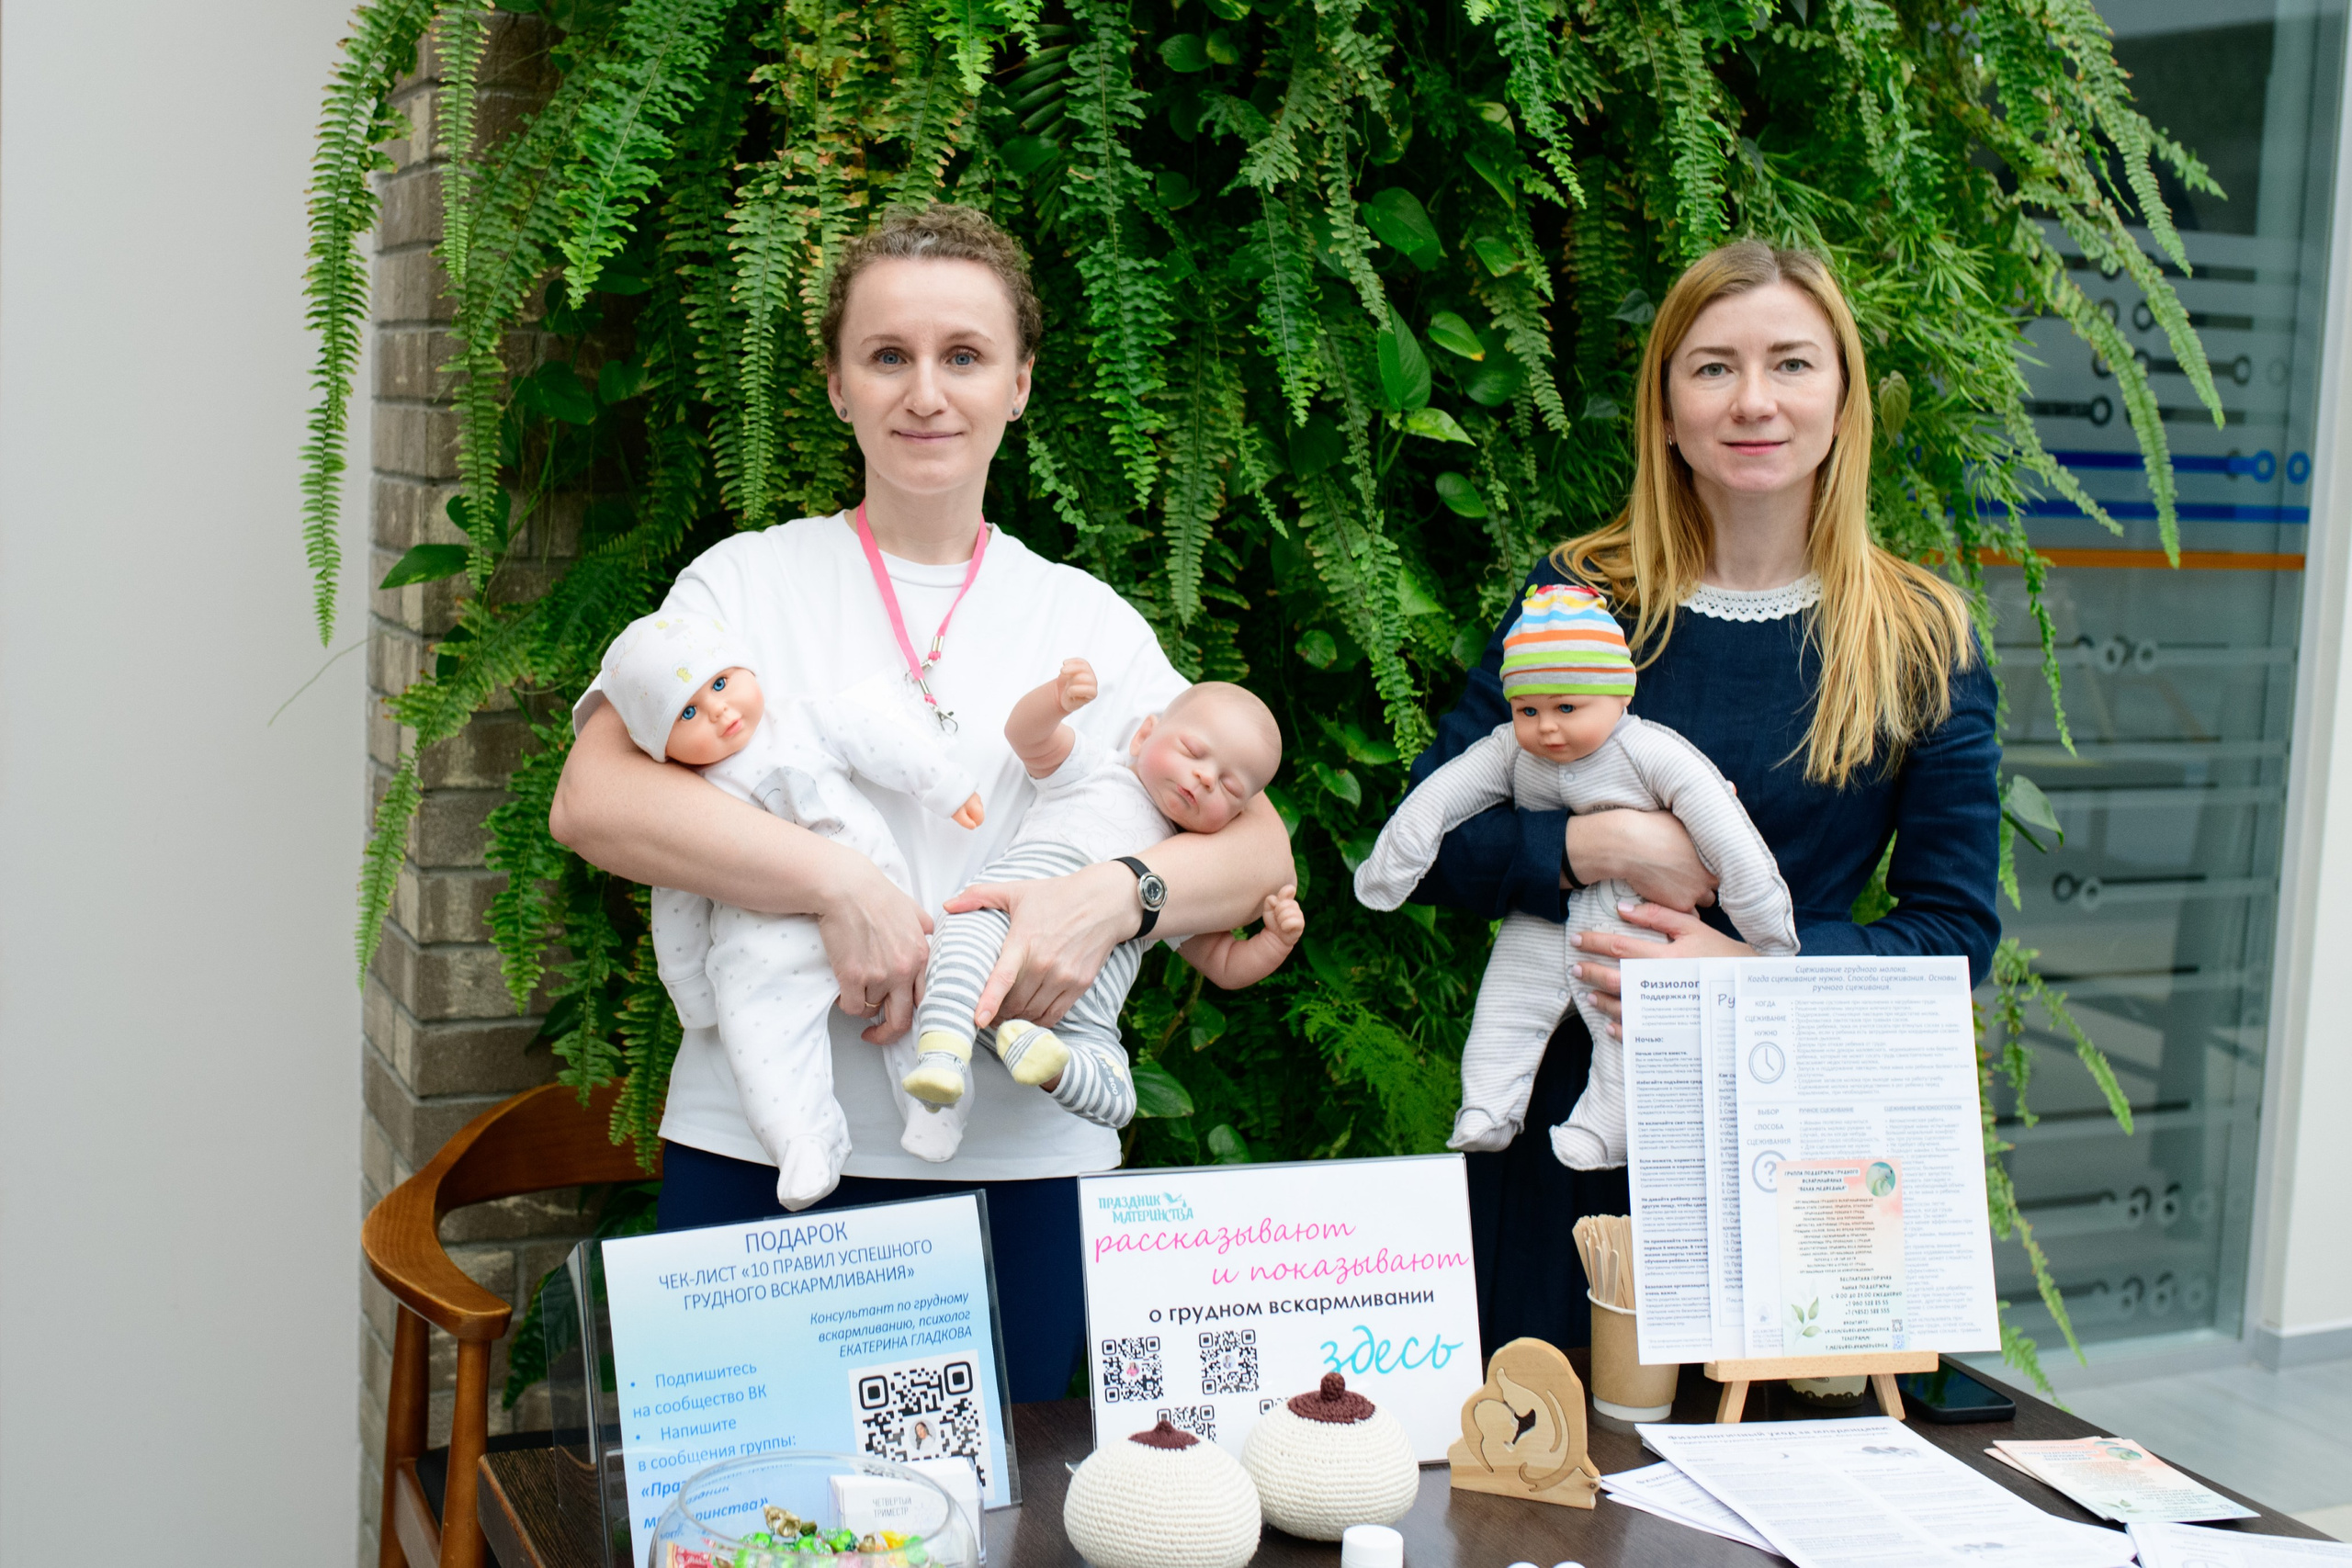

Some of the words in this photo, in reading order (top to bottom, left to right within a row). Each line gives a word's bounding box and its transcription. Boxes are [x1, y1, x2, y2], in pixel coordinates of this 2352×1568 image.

[1747, 975, 1770, 983] Когда
[1771, 976, 1816, 984] сцеживание
[1818, 976, 1845, 984] нужно.
[1848, 974, 1879, 983] Способы
[1881, 975, 1926, 984] сцеживания.
[1928, 974, 1957, 982] Основы
[1795, 965, 1842, 975] Сцеживание
[1844, 965, 1877, 975] грудного
[1641, 993, 1687, 1001] Поддержка
[1812, 984, 1843, 993] ручного
[1845, 984, 1892, 992] сцеживания.
[1745, 1015, 1787, 1023] СЦЕЖИВАНИЕ
[1755, 1000, 1776, 1009] КОГДА
[1757, 1108, 1780, 1116] ВЫБОР
[1746, 1138, 1792, 1146] СЦЕЖИВАНИЯ
[1098, 1194, 1160, 1211] ПРАЗДНИК
[1112, 1206, 1194, 1224] МАТЕРИНСТВА
[745, 1221, 849, 1253] ПОДАРОК
[1094, 1217, 1356, 1263] рассказывают
[659, 1265, 737, 1291] ЧЕК-ЛИСТ
[741, 1258, 770, 1280] «10
[773, 1252, 835, 1274] ПРАВИЛ
[837, 1238, 933, 1267] УСПЕШНОГО
[1212, 1267, 1239, 1286] и
[1250, 1247, 1469, 1285] показывают
[684, 1287, 767, 1311] ГРУДНОГО
[770, 1265, 915, 1300] ВСКАРМЛИВАНИЯ»
[809, 1303, 895, 1326] Консультант
[897, 1300, 911, 1314] по
[914, 1291, 969, 1315] грудному
[1149, 1308, 1162, 1323] о
[1170, 1300, 1263, 1325] грудном
[1269, 1290, 1435, 1315] вскармливании
[818, 1318, 916, 1343] вскармливанию,
[918, 1310, 971, 1331] психолог
[839, 1337, 909, 1359] ЕКАТЕРИНА
[910, 1325, 972, 1348] ГЛАДКОВА
[1320, 1325, 1464, 1376] здесь
[655, 1361, 757, 1390] Подпишитесь
[633, 1404, 651, 1418] на
[654, 1388, 744, 1417] сообщество
[748, 1383, 767, 1400] ВК
[660, 1416, 737, 1441] Напишите
[638, 1459, 646, 1472] в
[650, 1444, 736, 1471] сообщения
[740, 1435, 797, 1462] группы:
[874, 1506, 909, 1518] ТРИМЕСТР
